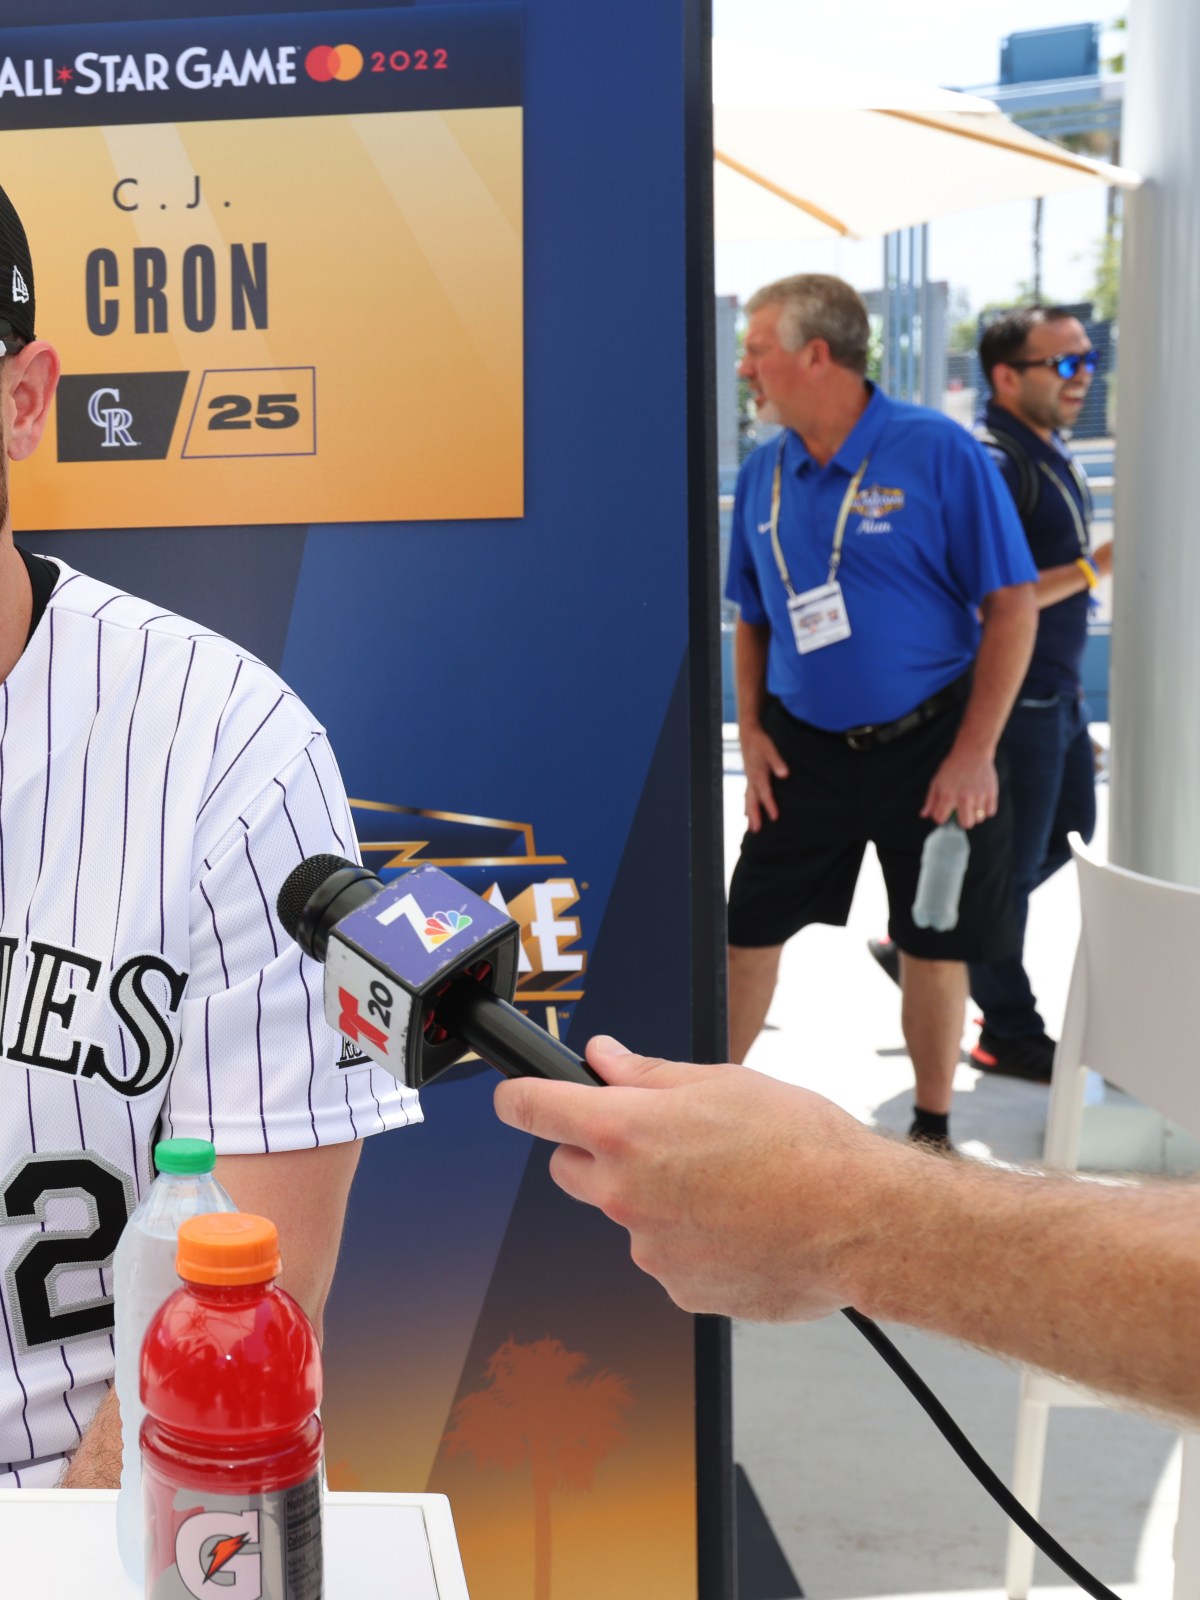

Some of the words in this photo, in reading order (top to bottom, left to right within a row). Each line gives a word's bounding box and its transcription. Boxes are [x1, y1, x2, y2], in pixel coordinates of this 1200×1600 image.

[176, 46, 296, 90] GAME
[371, 48, 448, 73] 2022
[85, 242, 269, 337] CRON
[207, 393, 300, 430] 25
[367, 980, 394, 1029] 20
